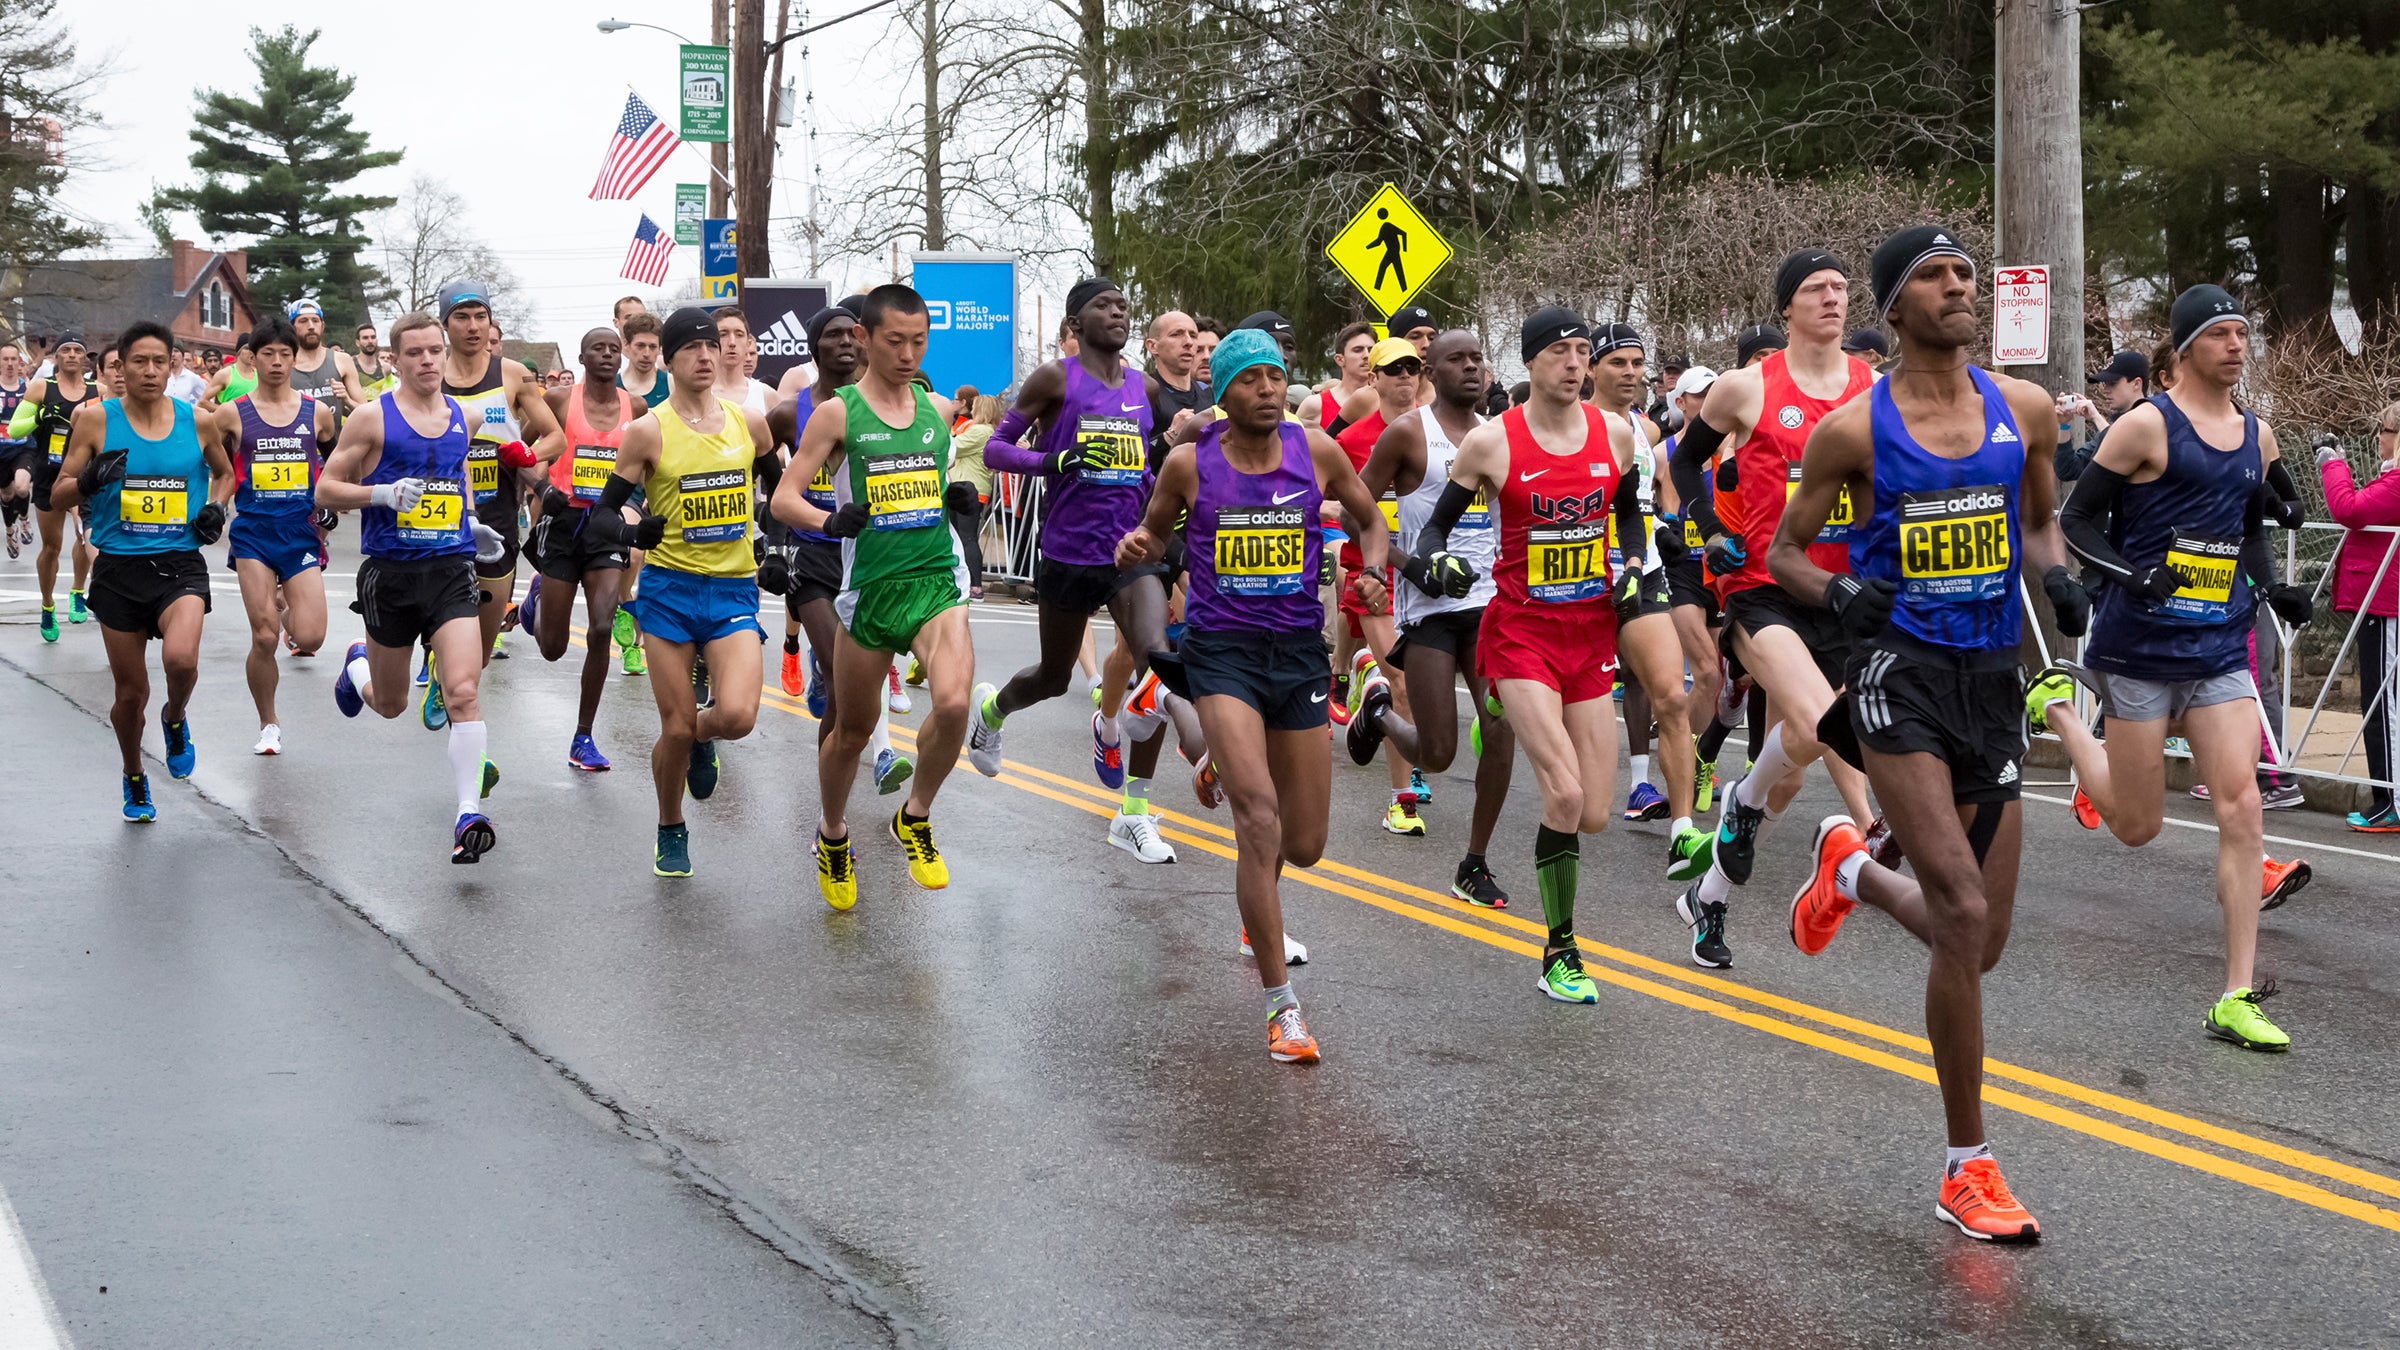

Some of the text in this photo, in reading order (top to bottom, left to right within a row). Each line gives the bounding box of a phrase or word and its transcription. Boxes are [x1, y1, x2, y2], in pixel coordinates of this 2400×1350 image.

[682, 52, 727, 60] HOPKINTON
[2013, 286, 2030, 297] NO
[2001, 298, 2043, 308] STOPPING
[756, 339, 809, 355] adida
[2002, 348, 2038, 357] MONDAY
[1106, 421, 1139, 433] adidas
[257, 437, 302, 450] 日立物流
[468, 448, 496, 458] didas
[597, 450, 616, 459] adid
[896, 456, 935, 469] adidas
[271, 467, 290, 482] 31
[470, 466, 496, 483] DAY
[575, 466, 612, 479] CHEPKW
[149, 479, 185, 489] adidas
[428, 481, 458, 492] adidas
[708, 474, 744, 486] adidas
[870, 480, 939, 503] HASEGAWA
[142, 496, 166, 514] 81
[420, 500, 446, 519] 54
[683, 492, 746, 522] SHAFAR
[1531, 486, 1604, 524] USA
[1948, 493, 2004, 513] adidas
[1251, 511, 1302, 524] adidas
[1562, 525, 1604, 540] adidas
[1218, 534, 1302, 568] TADESE
[1907, 518, 2007, 574] GEBRE
[2206, 542, 2240, 555] adidas
[1543, 544, 1594, 581] RITZ
[1927, 585, 1973, 593] MARATHON
[2173, 604, 2204, 613] MARATHON
